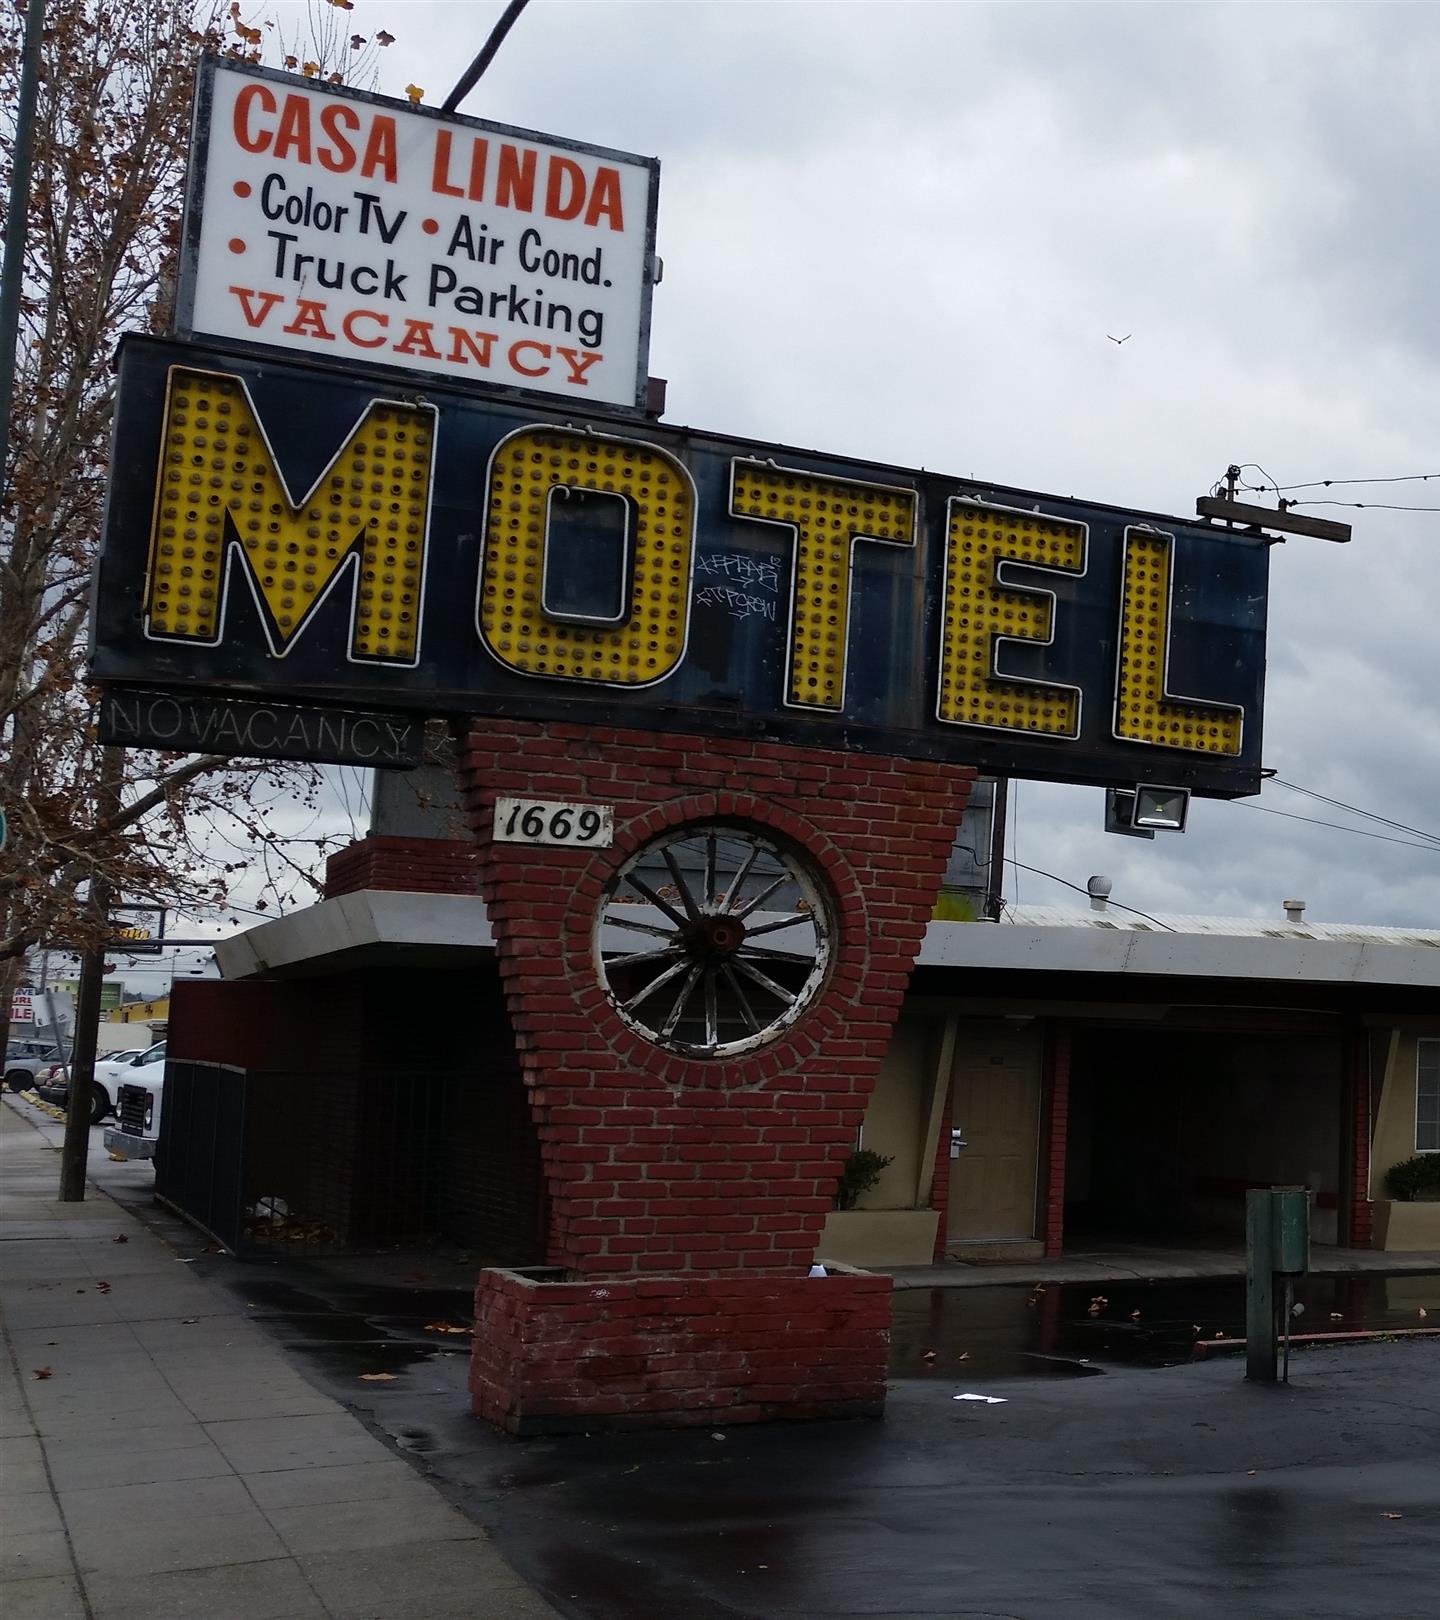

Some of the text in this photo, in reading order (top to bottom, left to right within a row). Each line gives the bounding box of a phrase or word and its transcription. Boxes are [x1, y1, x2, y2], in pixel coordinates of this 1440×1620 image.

[233, 84, 625, 233] CASA LINDA
[261, 173, 349, 233] Color
[447, 214, 504, 266] Air
[519, 229, 613, 288] Cond.
[229, 286, 604, 386] VACANCY
[267, 230, 604, 348] Truck Parking
[143, 364, 1243, 757] MOTEL
[505, 804, 601, 842] 1669
